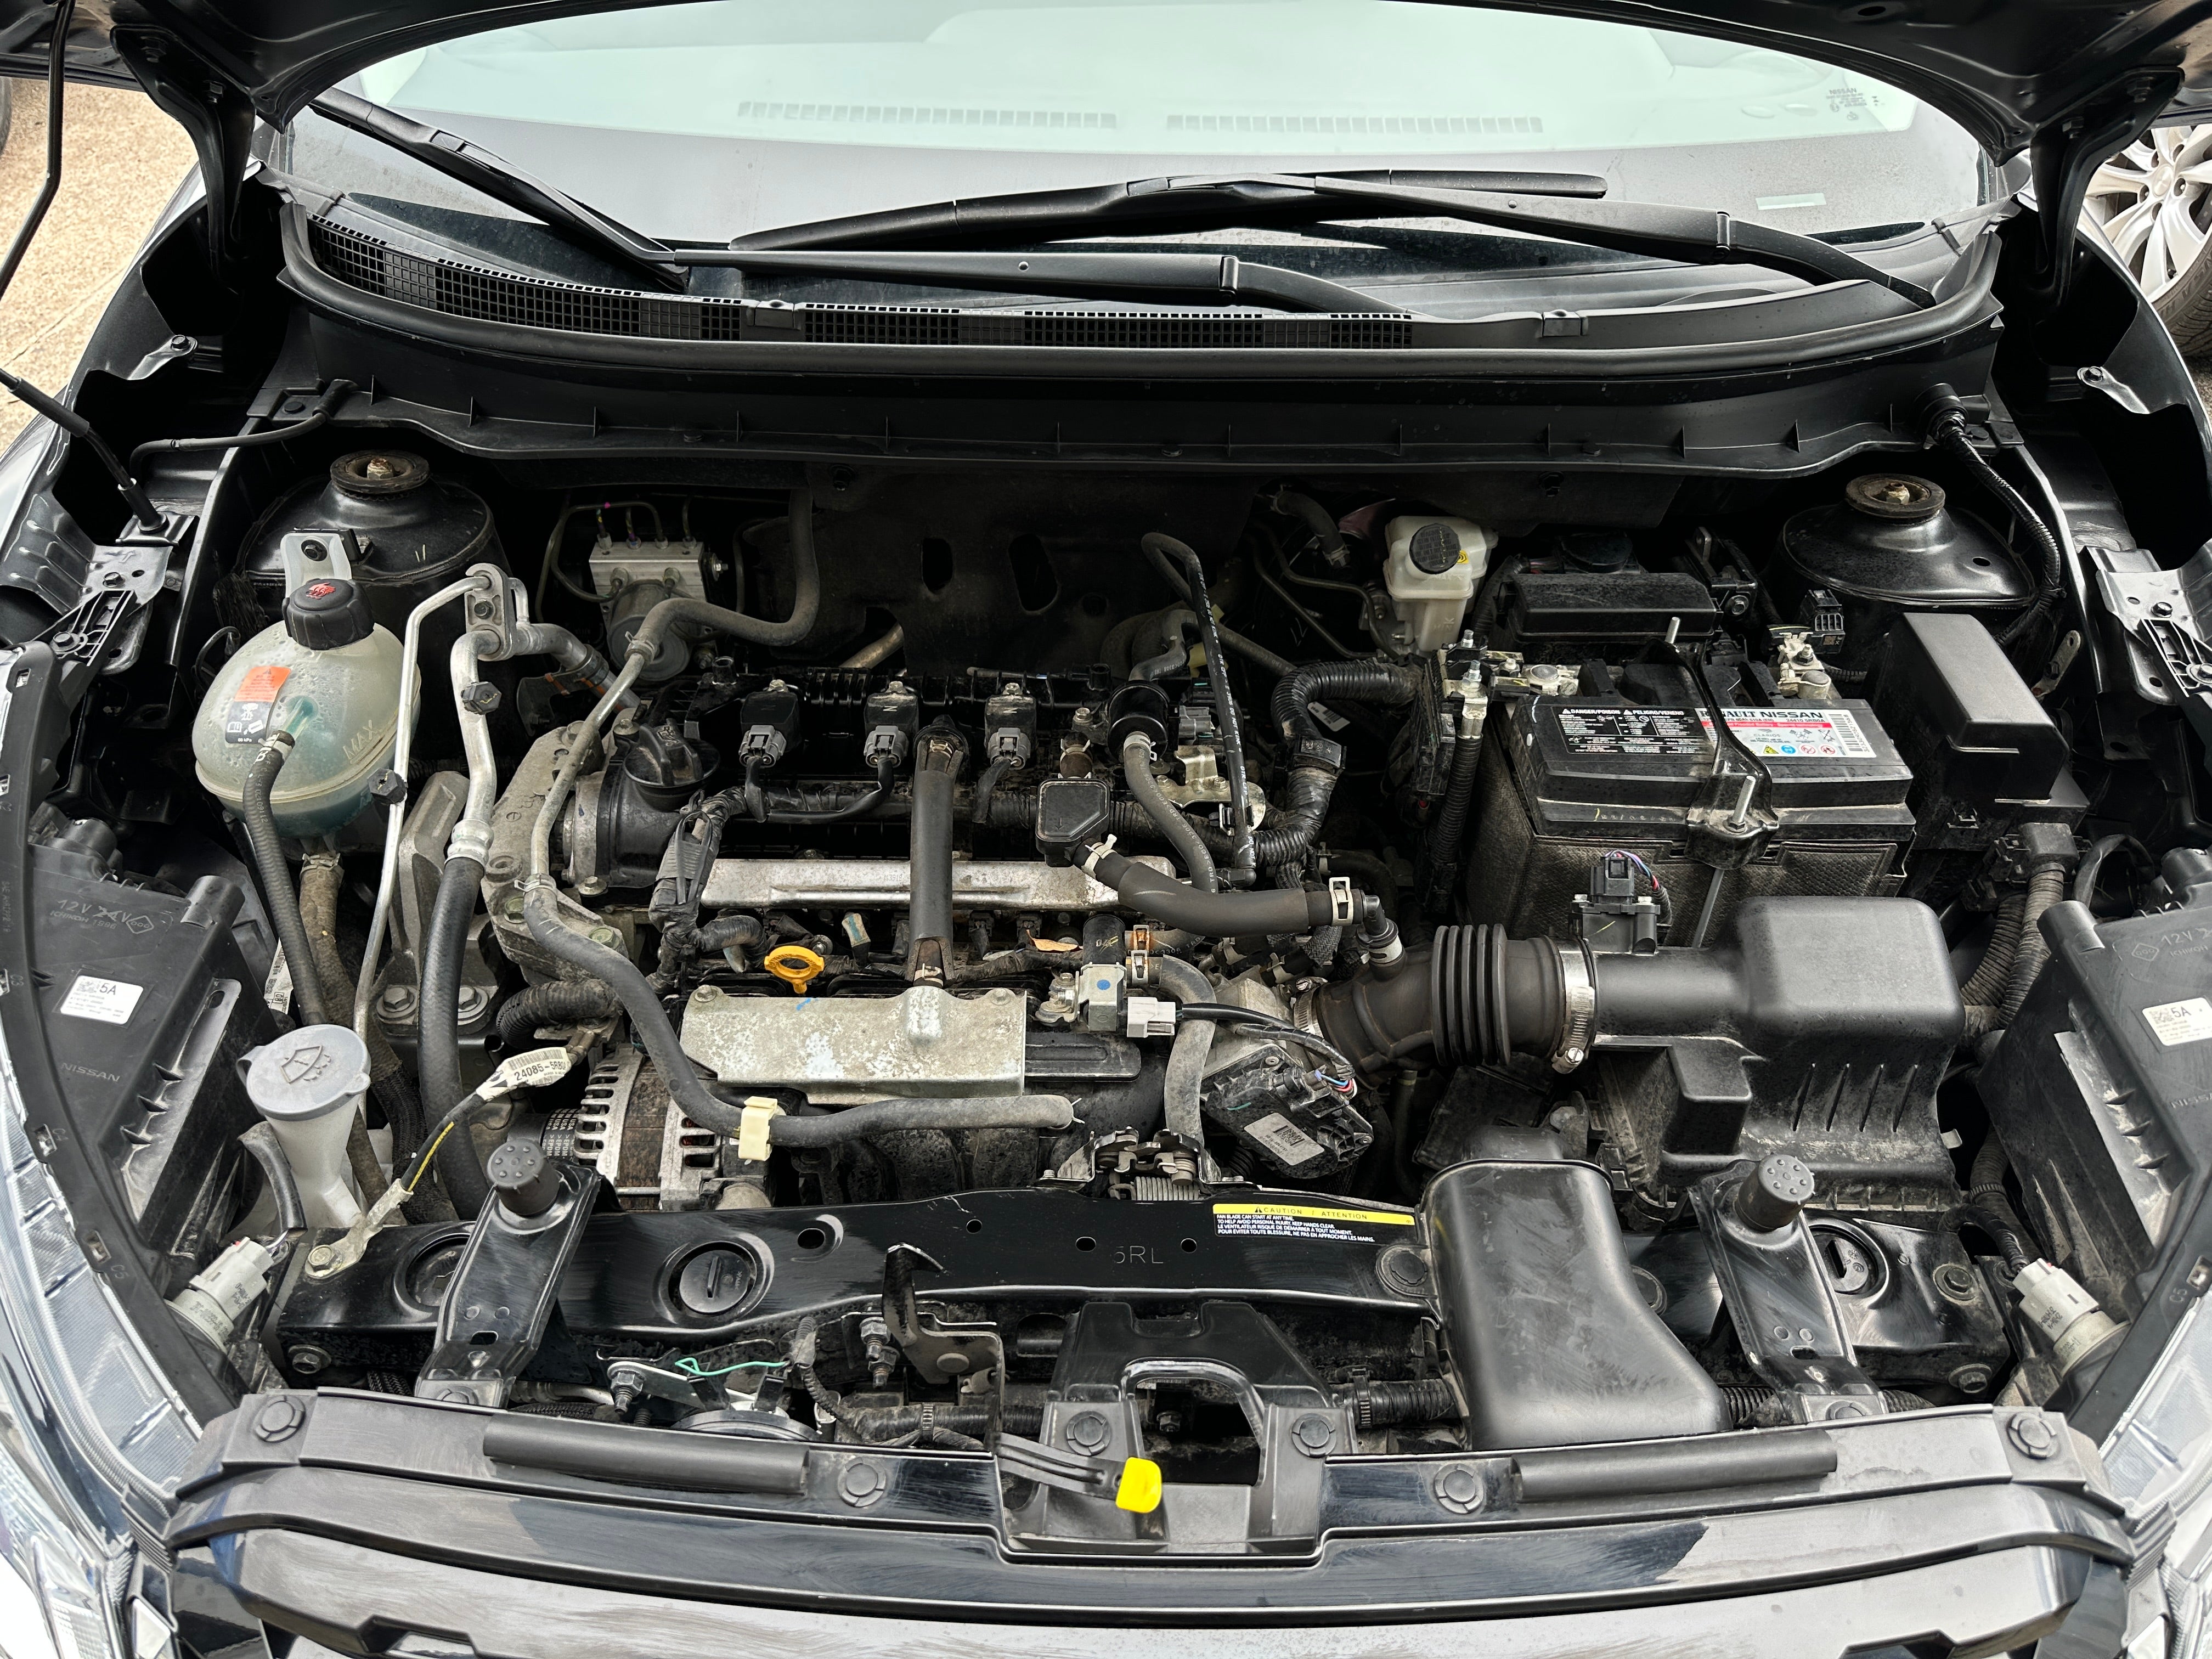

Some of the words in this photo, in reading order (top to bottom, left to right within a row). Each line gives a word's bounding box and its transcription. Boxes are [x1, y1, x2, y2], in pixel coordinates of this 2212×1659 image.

[99, 983, 116, 995] 5A
[2170, 1006, 2192, 1018] 5A
[61, 1062, 121, 1084] NISSAN
[1321, 1211, 1368, 1220] ATTENTION
